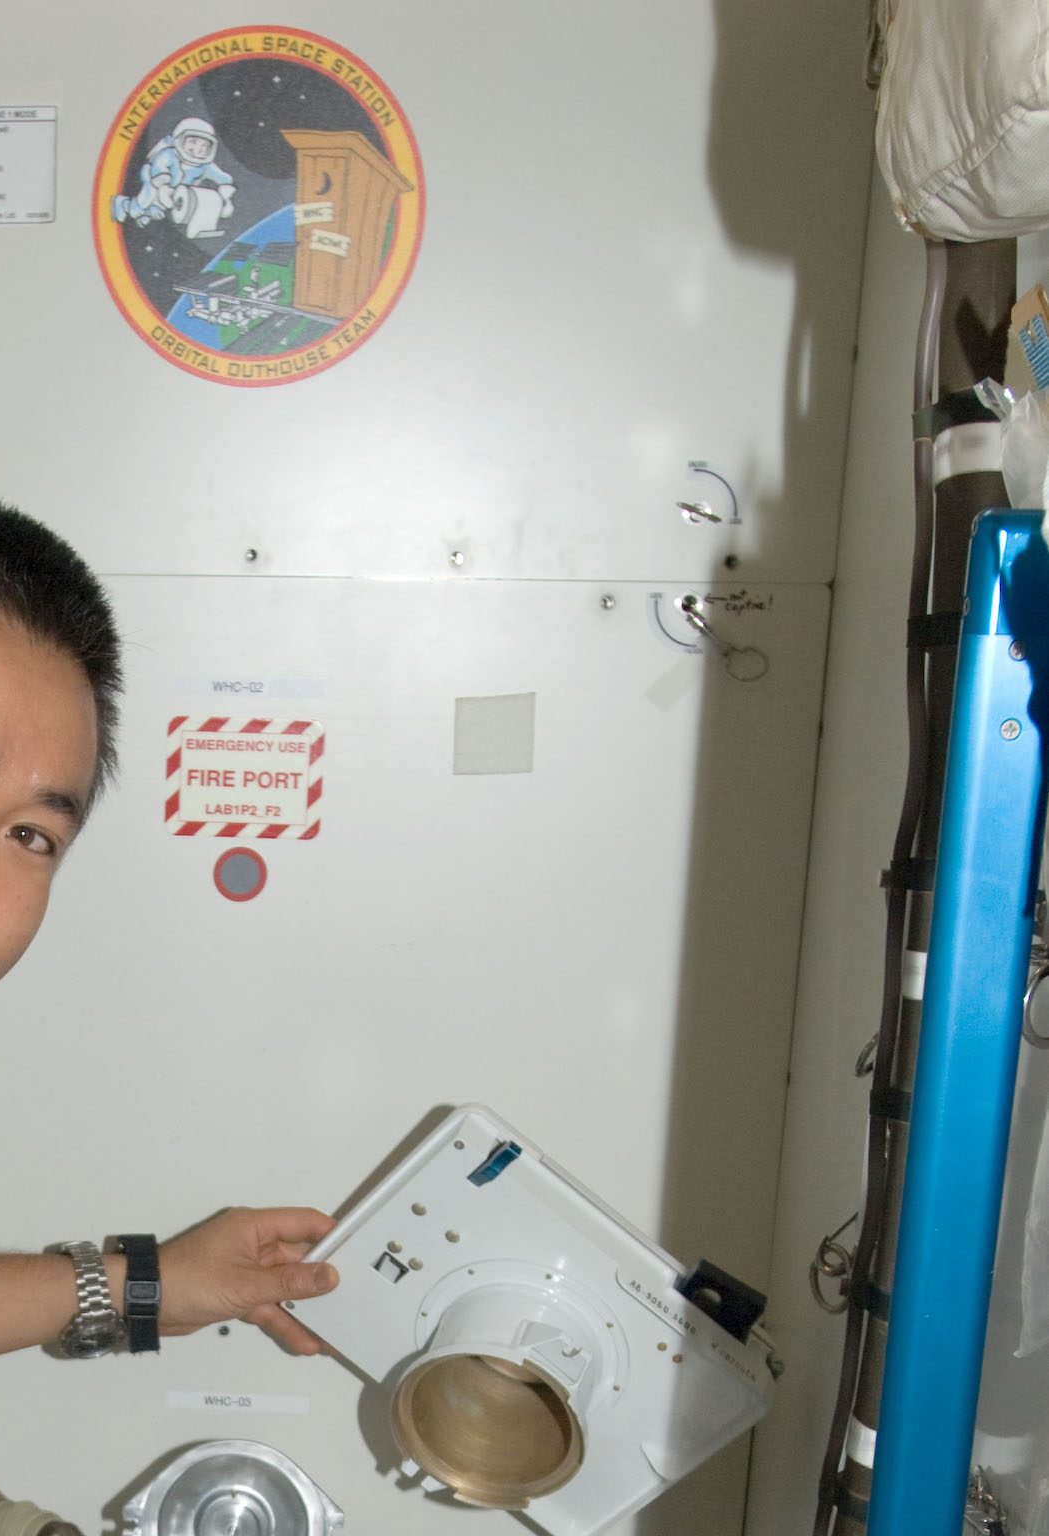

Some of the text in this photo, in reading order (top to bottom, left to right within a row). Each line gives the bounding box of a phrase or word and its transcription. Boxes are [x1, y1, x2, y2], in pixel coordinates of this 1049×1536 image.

[120, 35, 397, 140] INTERNATIONAL SPACE STATION
[150, 308, 379, 378] ORBITAL OUTHOUSE TEAM
[212, 681, 264, 693] WHC-02
[185, 738, 306, 753] EMERGENCY USE
[186, 769, 304, 789] FIRE PORT
[205, 803, 282, 818] LAB1P2_F2
